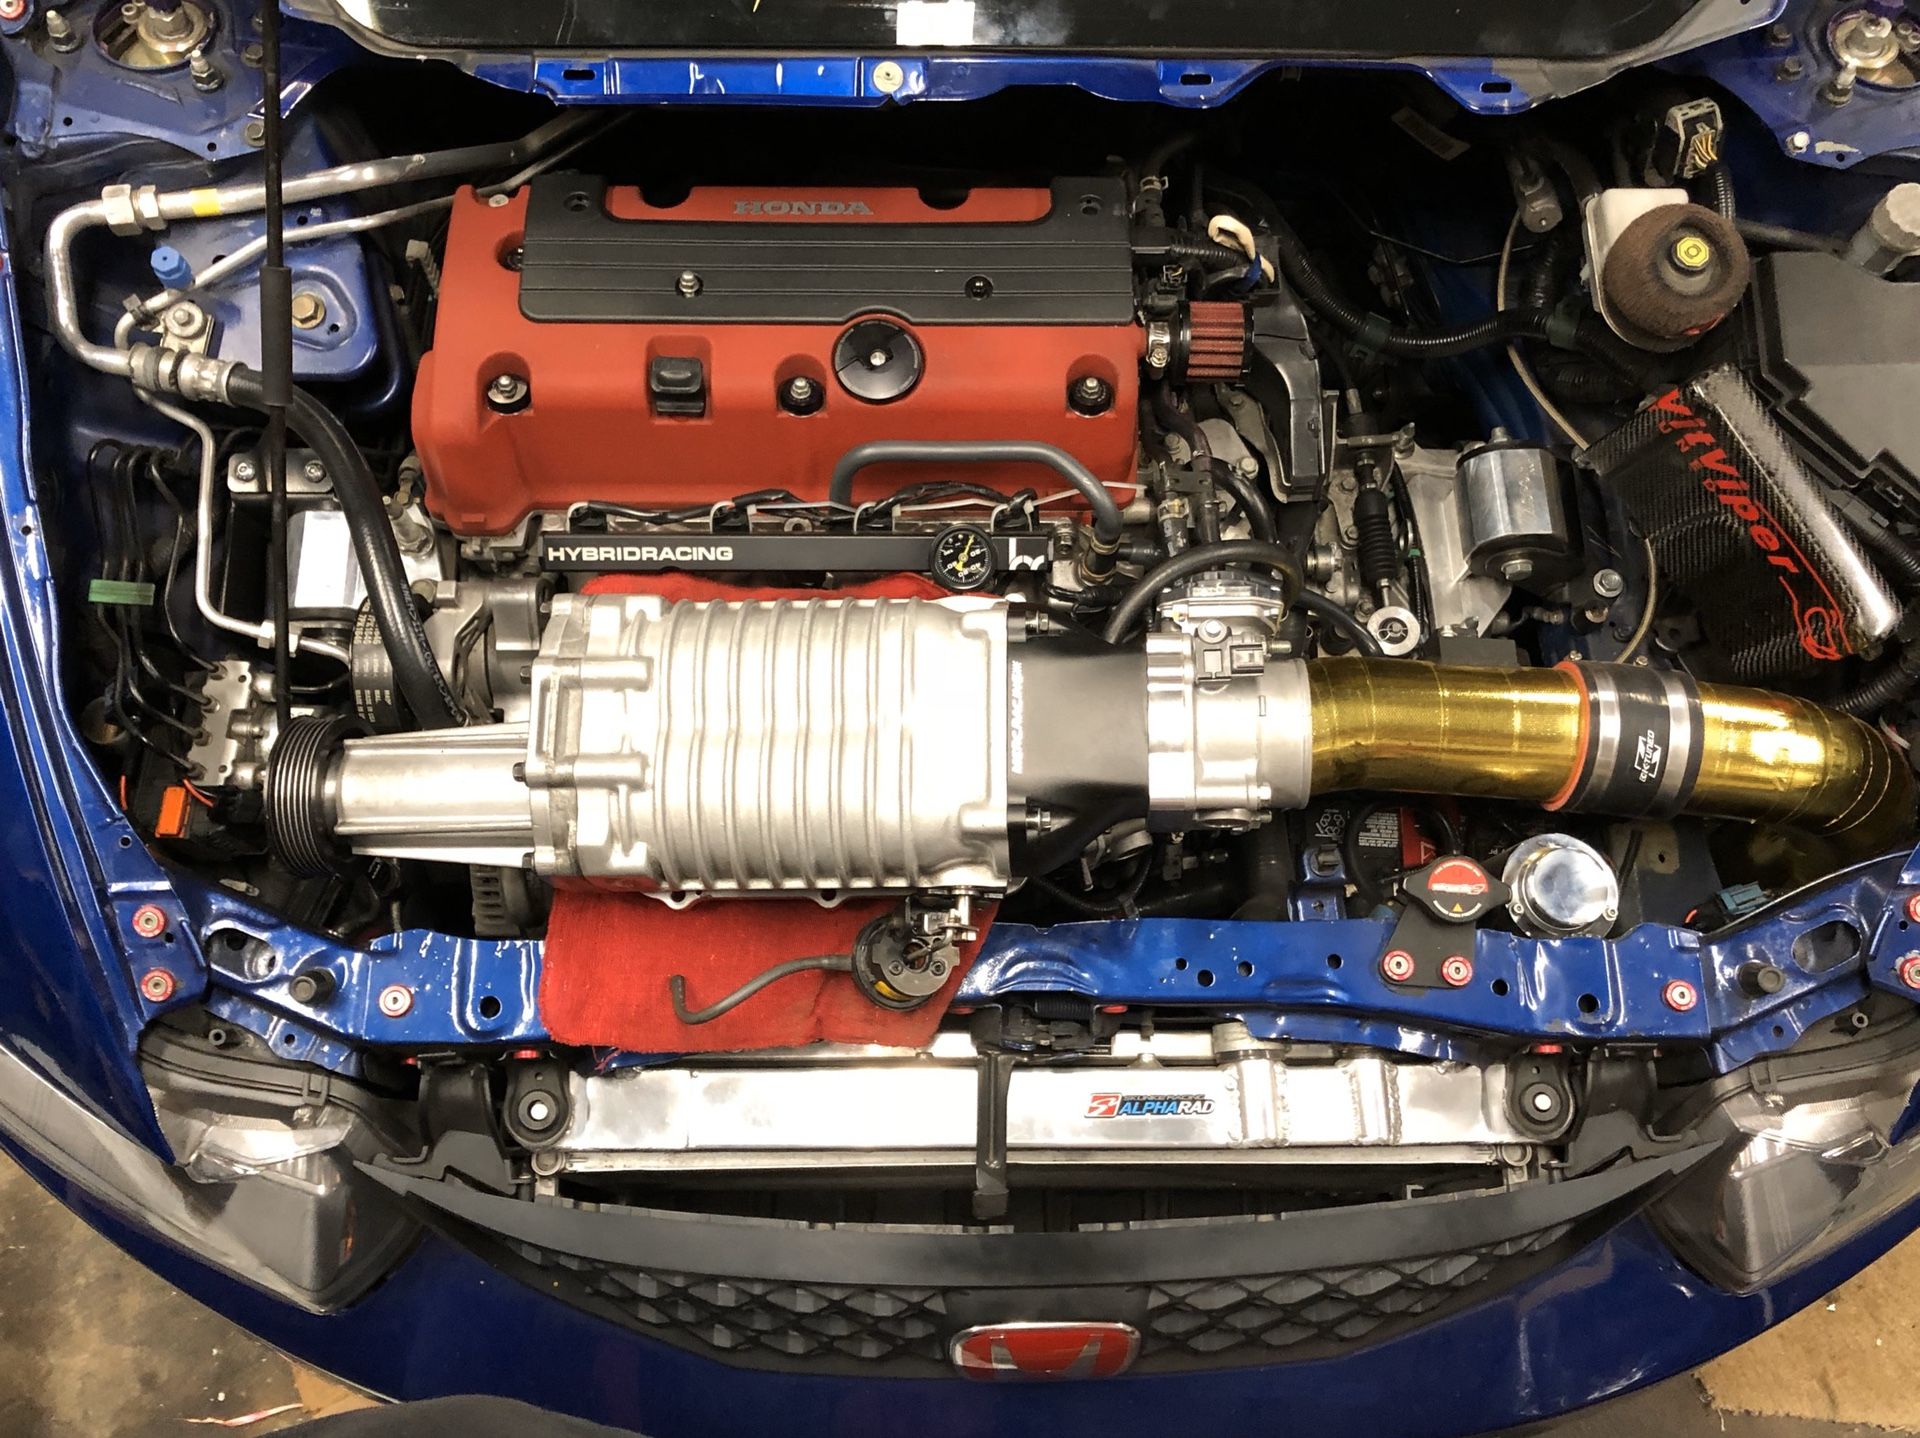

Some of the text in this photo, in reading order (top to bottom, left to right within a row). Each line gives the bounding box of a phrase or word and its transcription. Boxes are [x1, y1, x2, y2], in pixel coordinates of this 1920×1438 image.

[734, 200, 874, 215] HONDA
[548, 546, 733, 561] HYBRIDRACING
[1119, 1100, 1215, 1115] ALPHARAD
